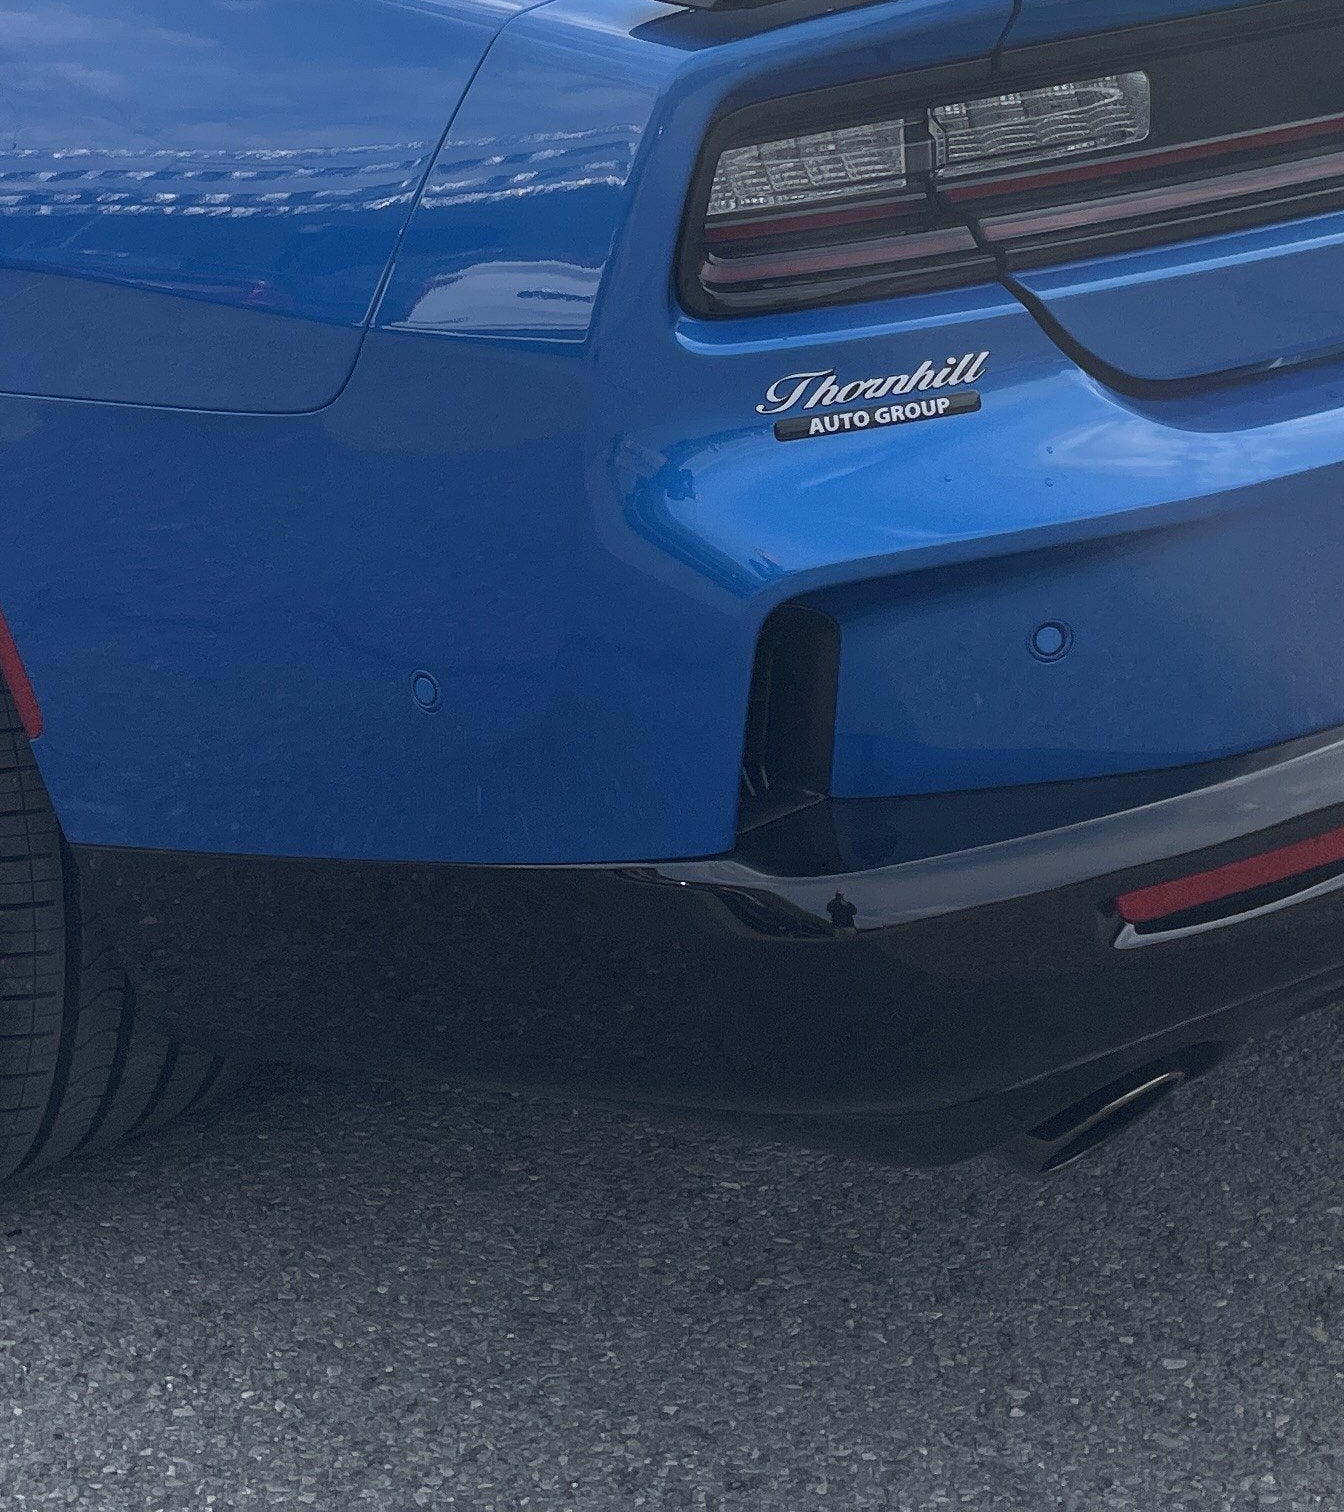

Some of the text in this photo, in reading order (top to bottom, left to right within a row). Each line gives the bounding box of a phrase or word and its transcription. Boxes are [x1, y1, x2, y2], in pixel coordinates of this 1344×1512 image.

[756, 351, 990, 414] Thornhill
[809, 397, 951, 435] AUTO GROUP
